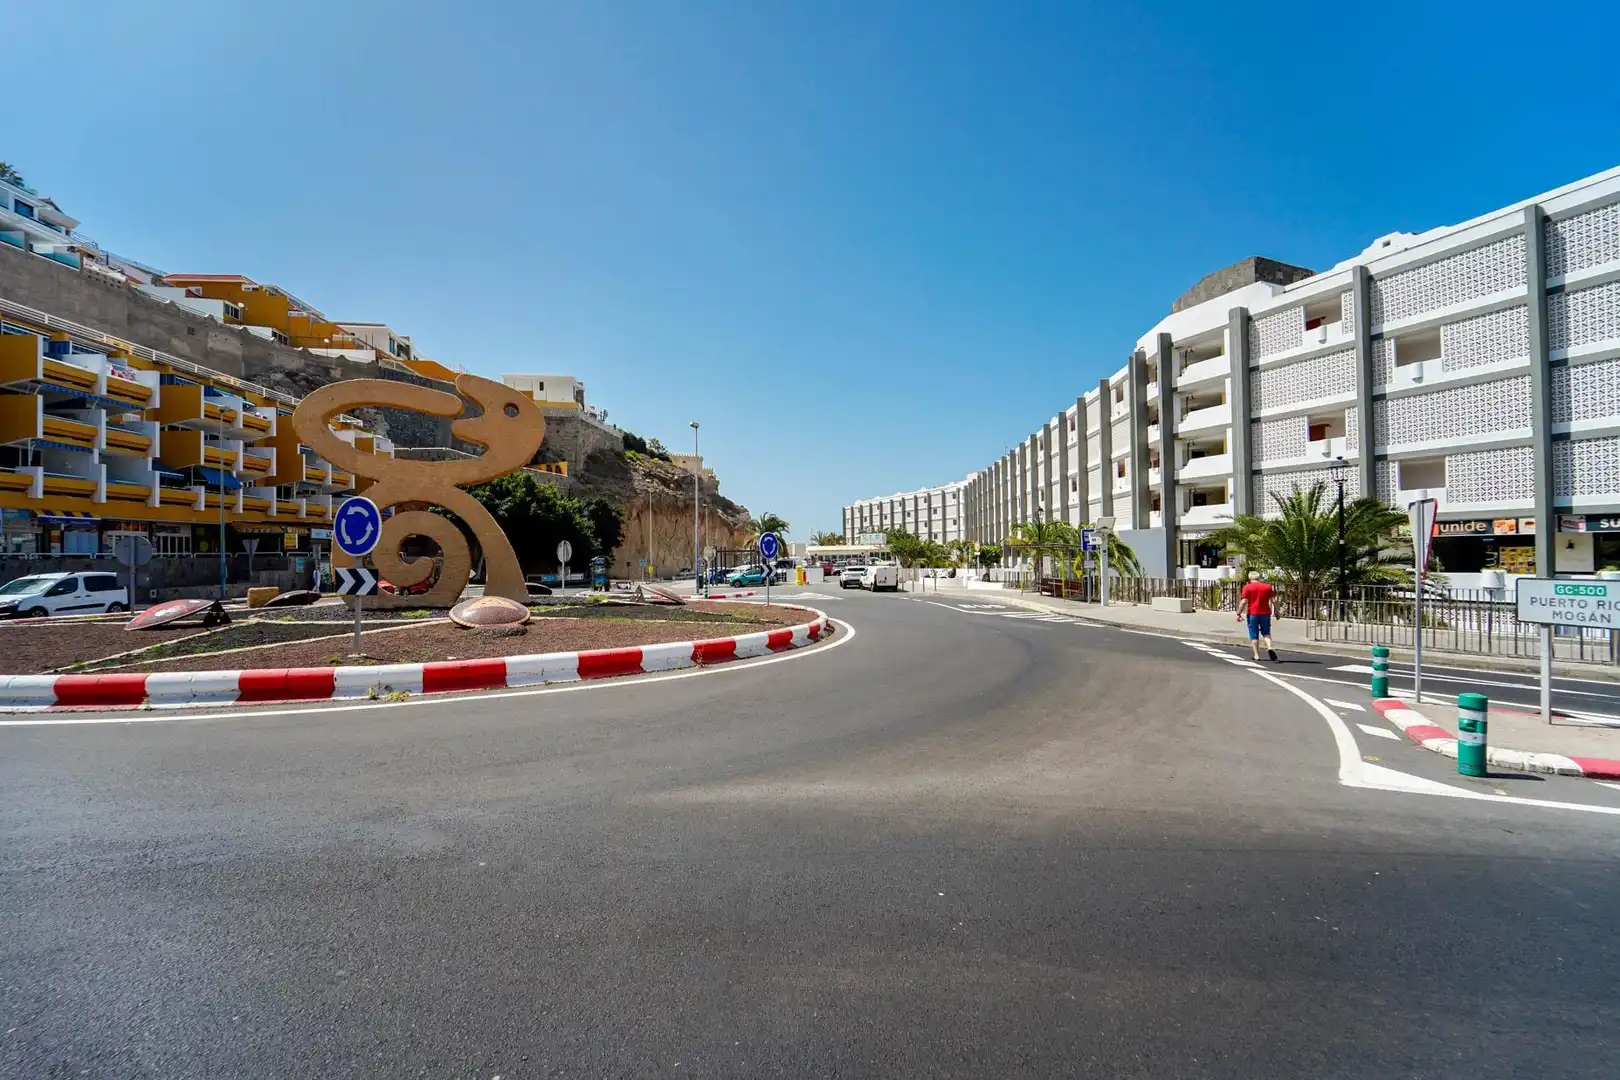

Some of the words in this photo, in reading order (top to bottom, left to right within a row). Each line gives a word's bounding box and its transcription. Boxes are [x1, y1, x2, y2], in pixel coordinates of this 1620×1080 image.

[1440, 520, 1487, 532] unide
[1556, 585, 1605, 596] GC-500
[1530, 596, 1588, 609] PUERTO
[1552, 610, 1612, 623] MOGÁN
